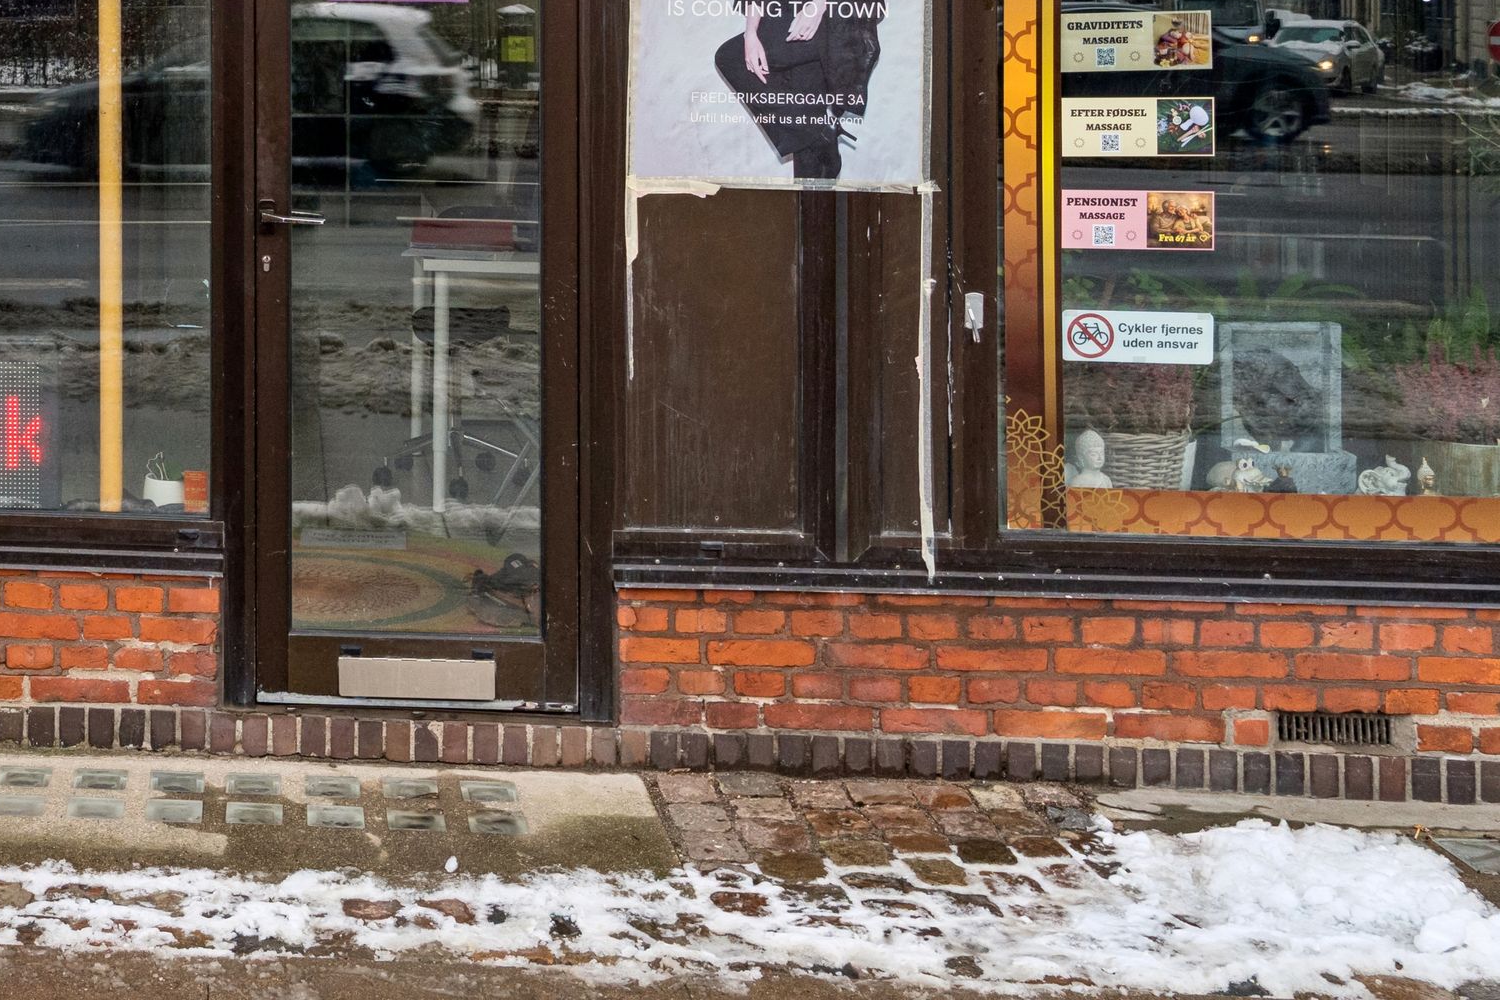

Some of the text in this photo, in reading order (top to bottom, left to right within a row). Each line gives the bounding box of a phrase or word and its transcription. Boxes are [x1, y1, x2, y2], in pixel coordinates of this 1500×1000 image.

[667, 0, 890, 19] IS COMING TO TOWN
[1067, 20, 1143, 31] GRAVIDITETS
[1082, 36, 1128, 45] MASSAGE
[691, 92, 865, 106] FREDERIKSBERGGADE 3A
[1070, 108, 1147, 118] EFTER FØDSEL
[690, 112, 864, 128] Until then, visit us at nelly.com
[1086, 123, 1132, 131] MASSAGE
[1066, 197, 1138, 207] PENSIONIST
[1079, 212, 1126, 220] MASSAGE
[1158, 233, 1197, 243] Fra 67 år
[1118, 322, 1203, 336] Cykler fjernes
[1122, 339, 1198, 349] uden ansvar
